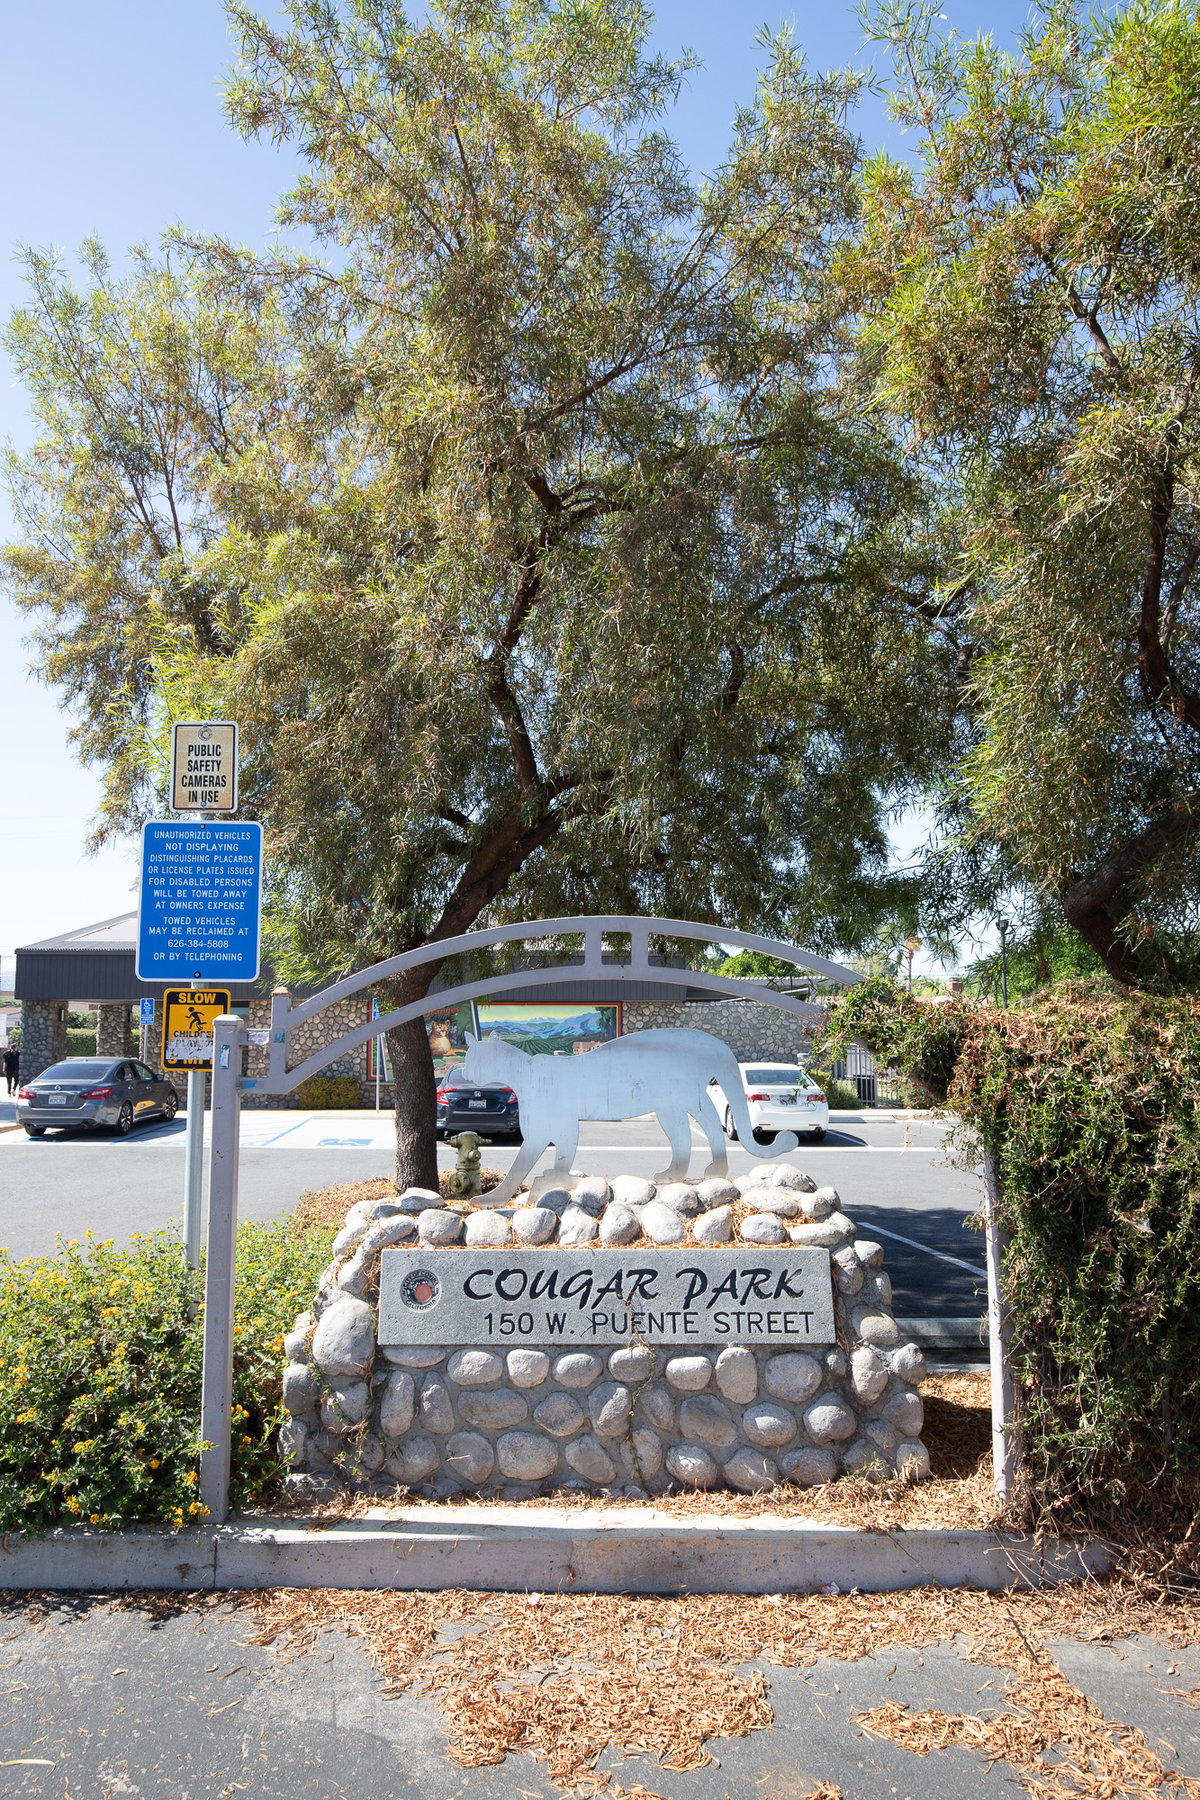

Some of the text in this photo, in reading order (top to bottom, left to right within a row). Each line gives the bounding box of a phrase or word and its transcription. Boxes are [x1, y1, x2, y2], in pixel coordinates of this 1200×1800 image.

[188, 744, 222, 757] PUBLIC
[187, 760, 222, 772] SAFETY
[181, 775, 227, 788] CAMERAS
[188, 790, 219, 803] IN USE
[154, 831, 251, 841] UNAUTHORIZED VEHICLES
[165, 842, 239, 852] NOT DISPLAYING
[150, 854, 254, 864] DISTINGUISHING PLACARDS
[147, 865, 255, 875] OR LICENSE PLATES ISSUED
[148, 877, 253, 887] FOR DISABLED PERSONS
[153, 889, 248, 899] WILL BE TOWED AWAY
[155, 901, 245, 910] AT OWNERS EXPENSE
[163, 916, 236, 926] TOWED VEHICLES
[148, 926, 249, 936] MAY BE RECLAIMED AT
[167, 938, 229, 948] 626-384-5808
[153, 952, 243, 961] OR BY TELEPHONING
[178, 992, 217, 1004] SLOW
[463, 1267, 804, 1310] COUGAR PARK
[484, 1311, 814, 1335] 150 W. PUENTE STREET
